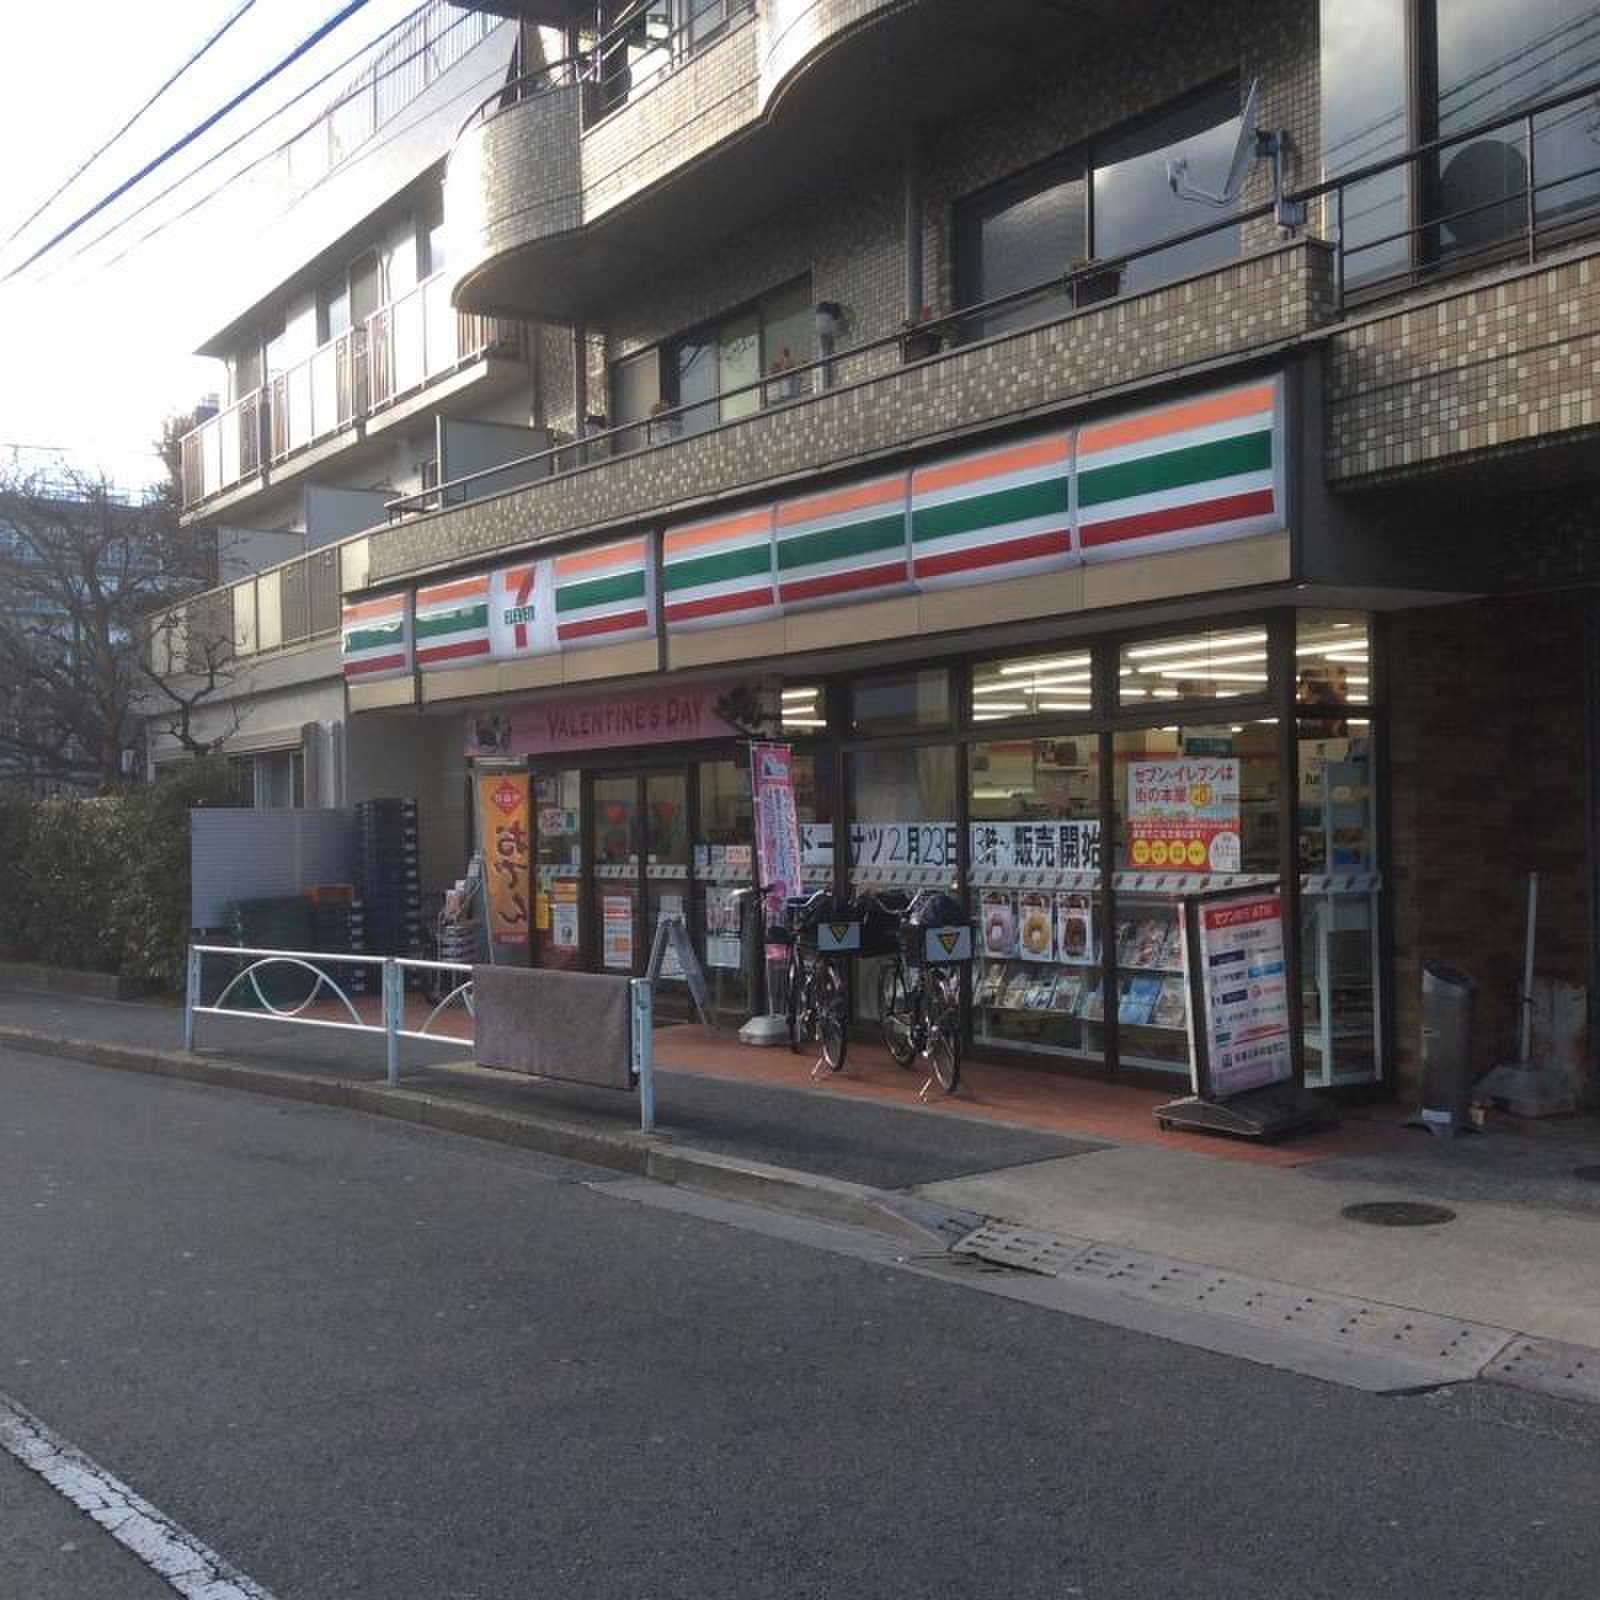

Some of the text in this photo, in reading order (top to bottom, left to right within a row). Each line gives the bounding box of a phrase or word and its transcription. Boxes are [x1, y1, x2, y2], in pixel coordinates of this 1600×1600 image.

[505, 567, 535, 648] 7
[546, 697, 704, 740] VALENTINE'S DAY
